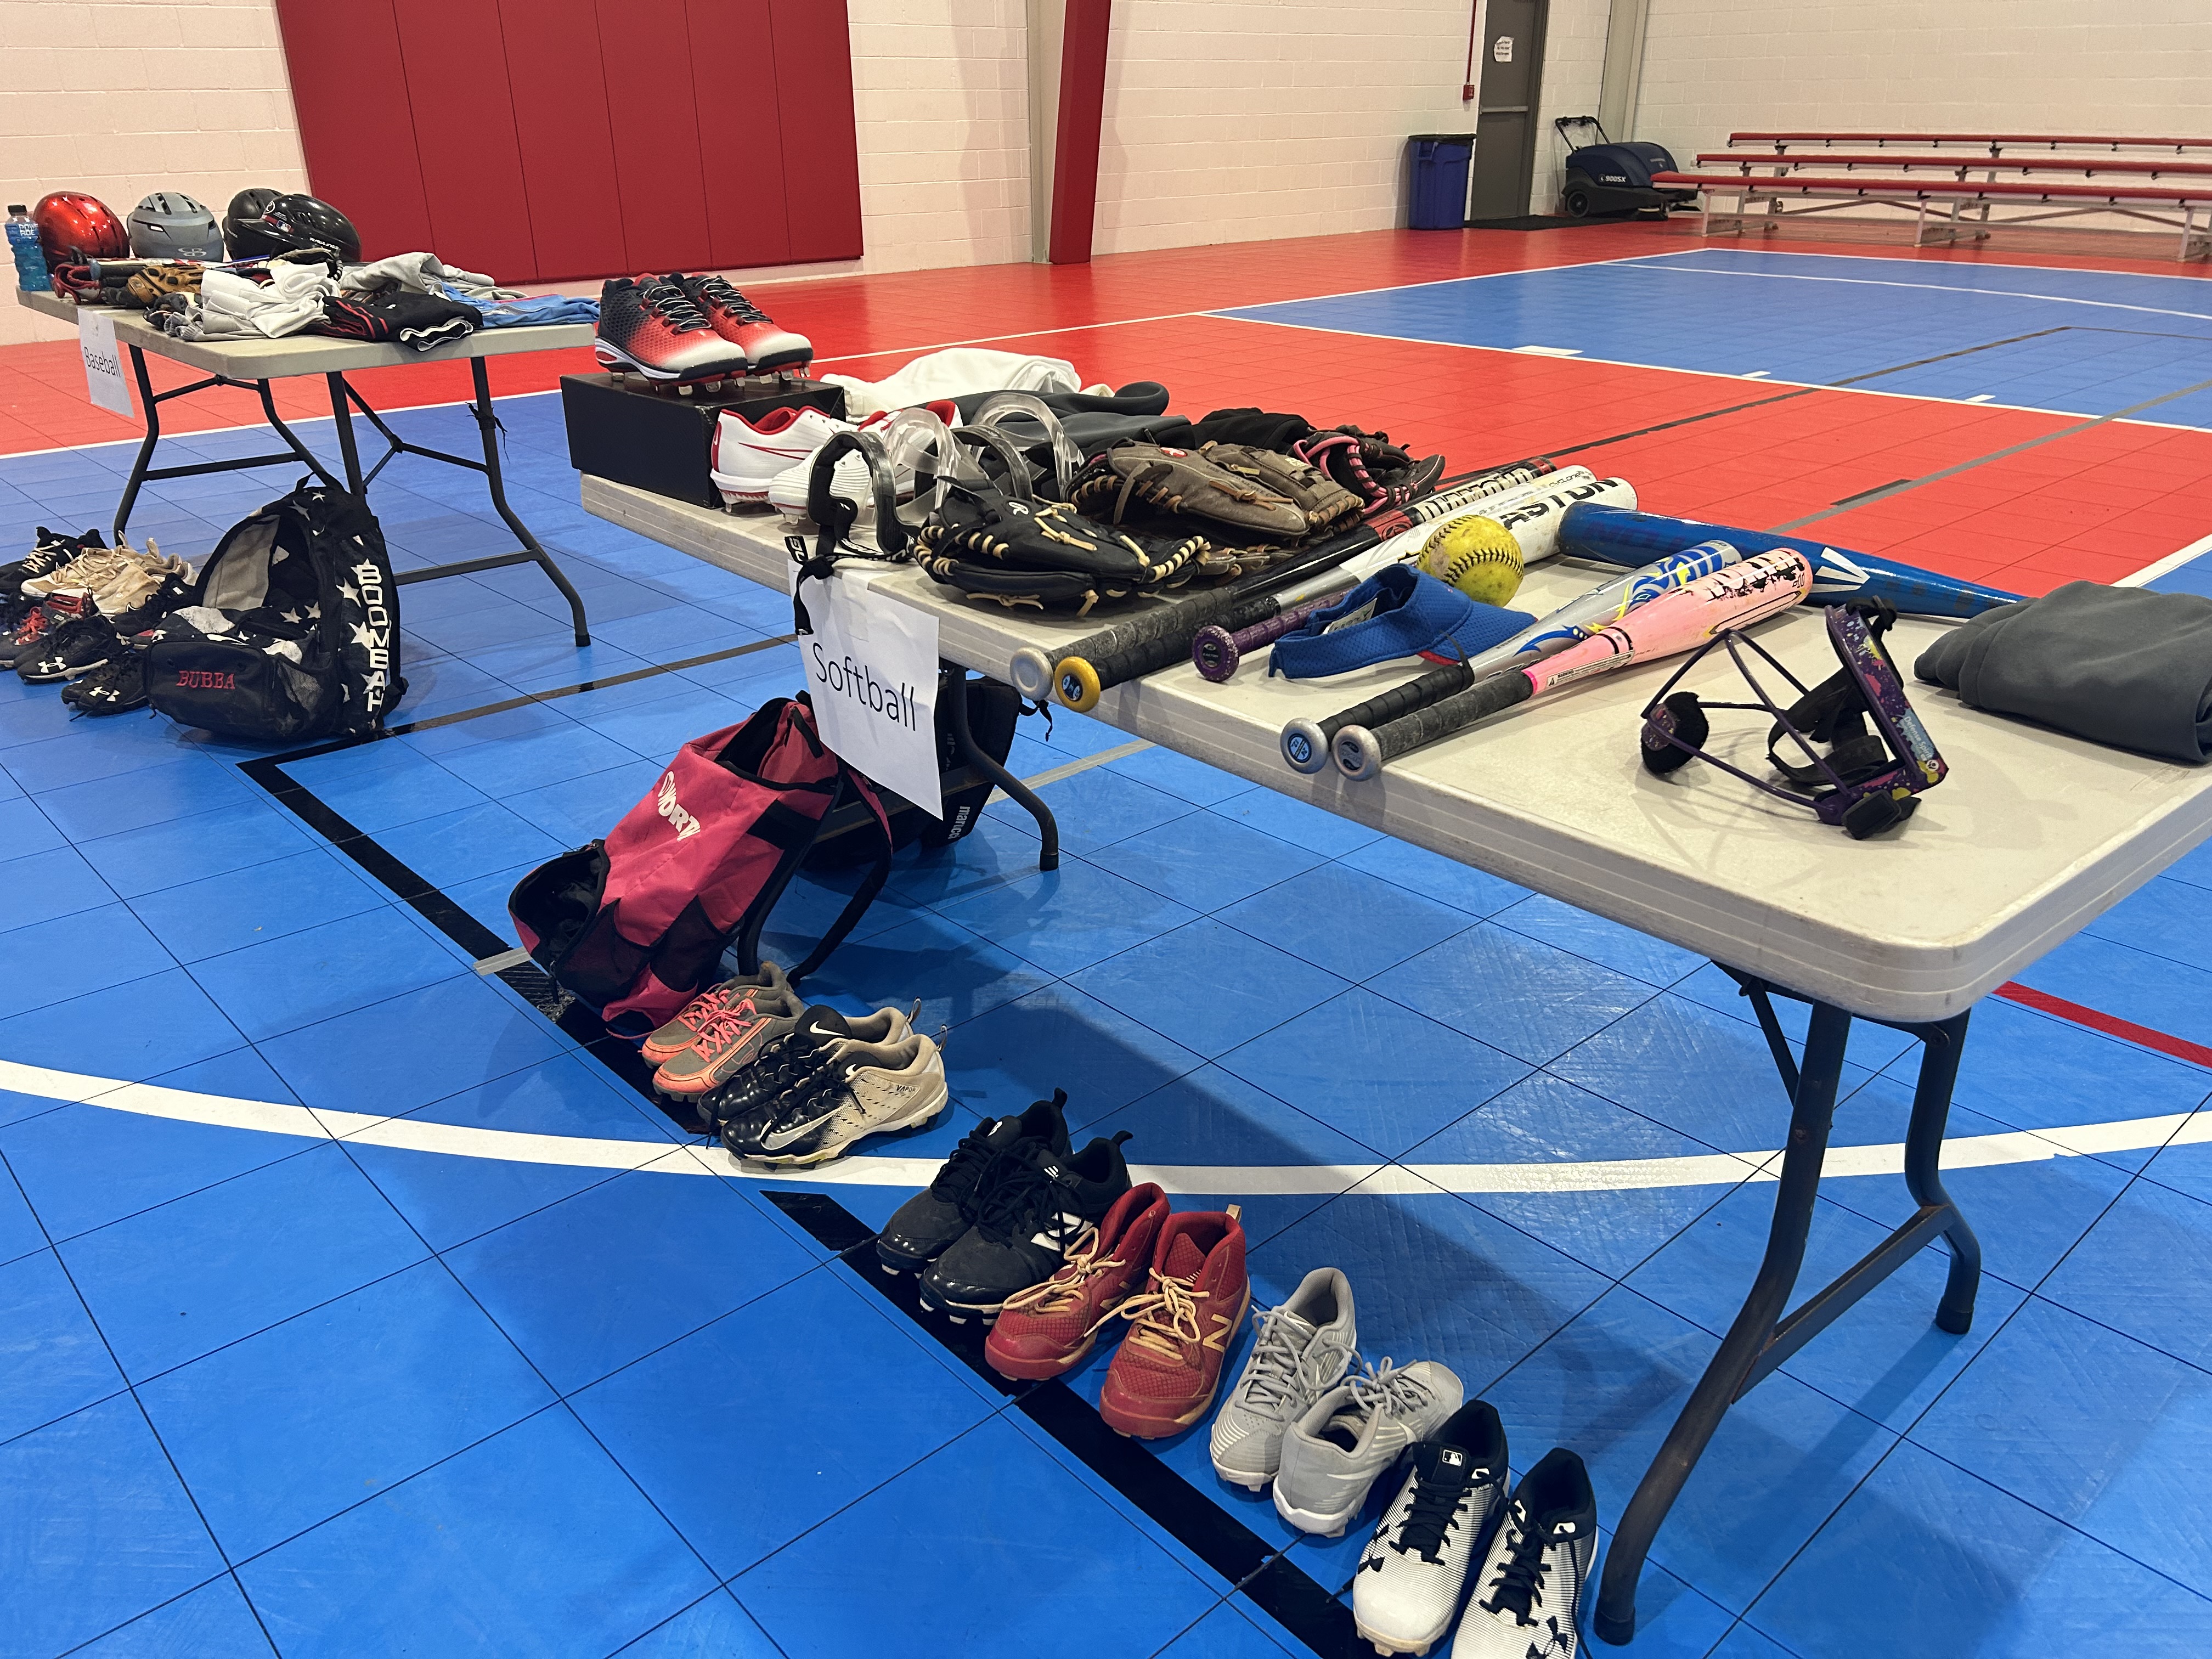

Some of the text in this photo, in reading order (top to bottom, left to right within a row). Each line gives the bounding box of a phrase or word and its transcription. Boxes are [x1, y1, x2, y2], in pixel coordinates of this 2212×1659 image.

[309, 237, 339, 250] RAWLINGS
[84, 346, 121, 377] Baseball
[1498, 476, 1618, 530] ASTON
[357, 563, 390, 712] BOOMBAH
[176, 670, 236, 690] BUBBA
[812, 642, 916, 732] Softball
[1903, 716, 1922, 742] Defense
[1919, 741, 1934, 760] Spirit
[947, 805, 970, 839] marucci
[896, 1084, 916, 1092] VAPOR
